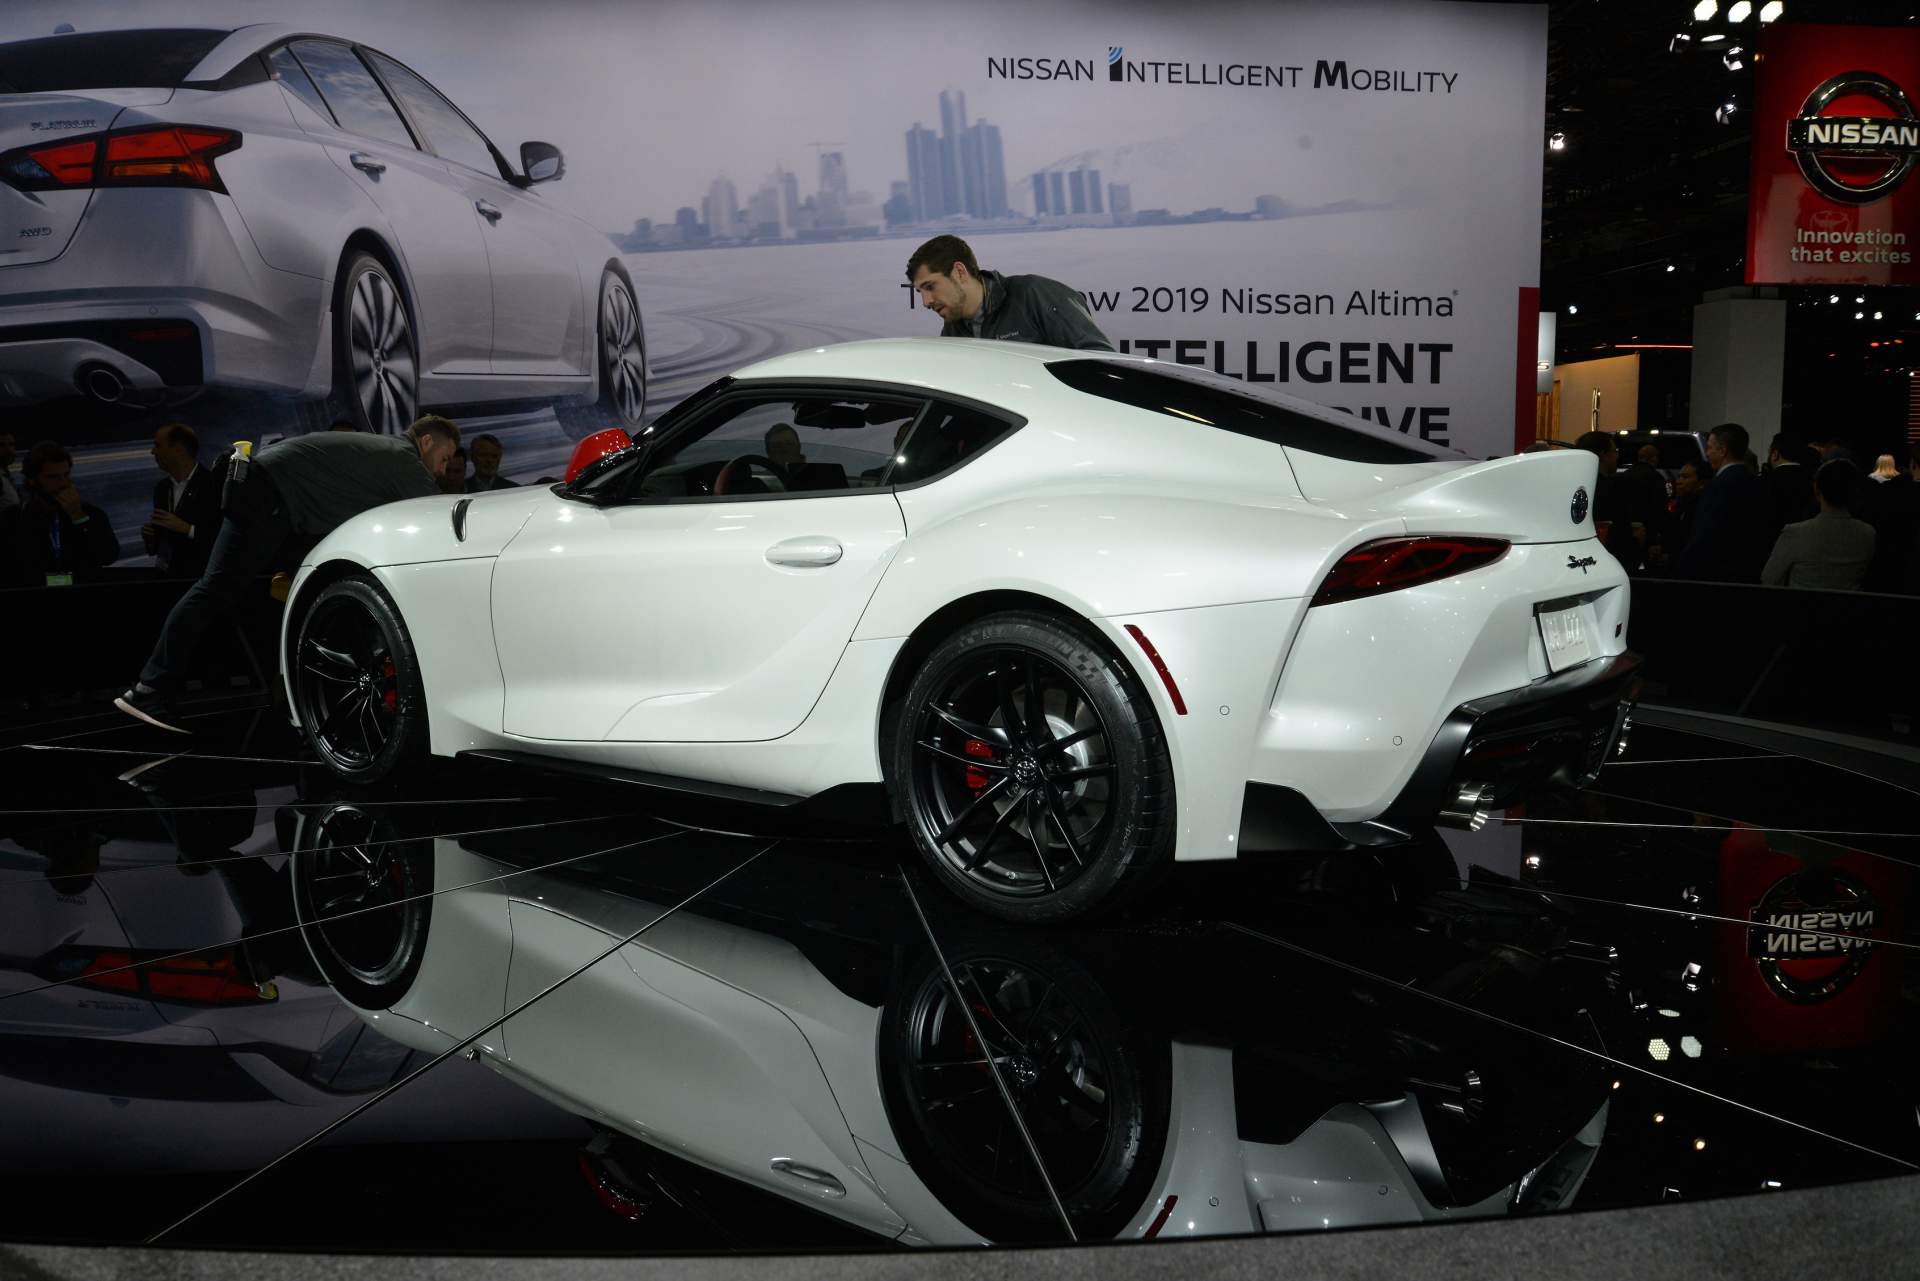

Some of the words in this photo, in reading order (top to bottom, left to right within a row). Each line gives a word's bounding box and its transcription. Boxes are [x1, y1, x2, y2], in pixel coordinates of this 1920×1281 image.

[987, 56, 1095, 82] NISSAN
[1108, 46, 1304, 88] INTELLIGENT
[1313, 59, 1460, 94] MOBILITY
[1807, 123, 1919, 147] NISSAN
[1797, 228, 1907, 246] Innovation
[1790, 246, 1834, 263] that
[1838, 247, 1912, 265] excites
[1131, 286, 1210, 314] 2019
[1221, 287, 1335, 316] Nissan
[1119, 339, 1454, 385] TELLIGENT
